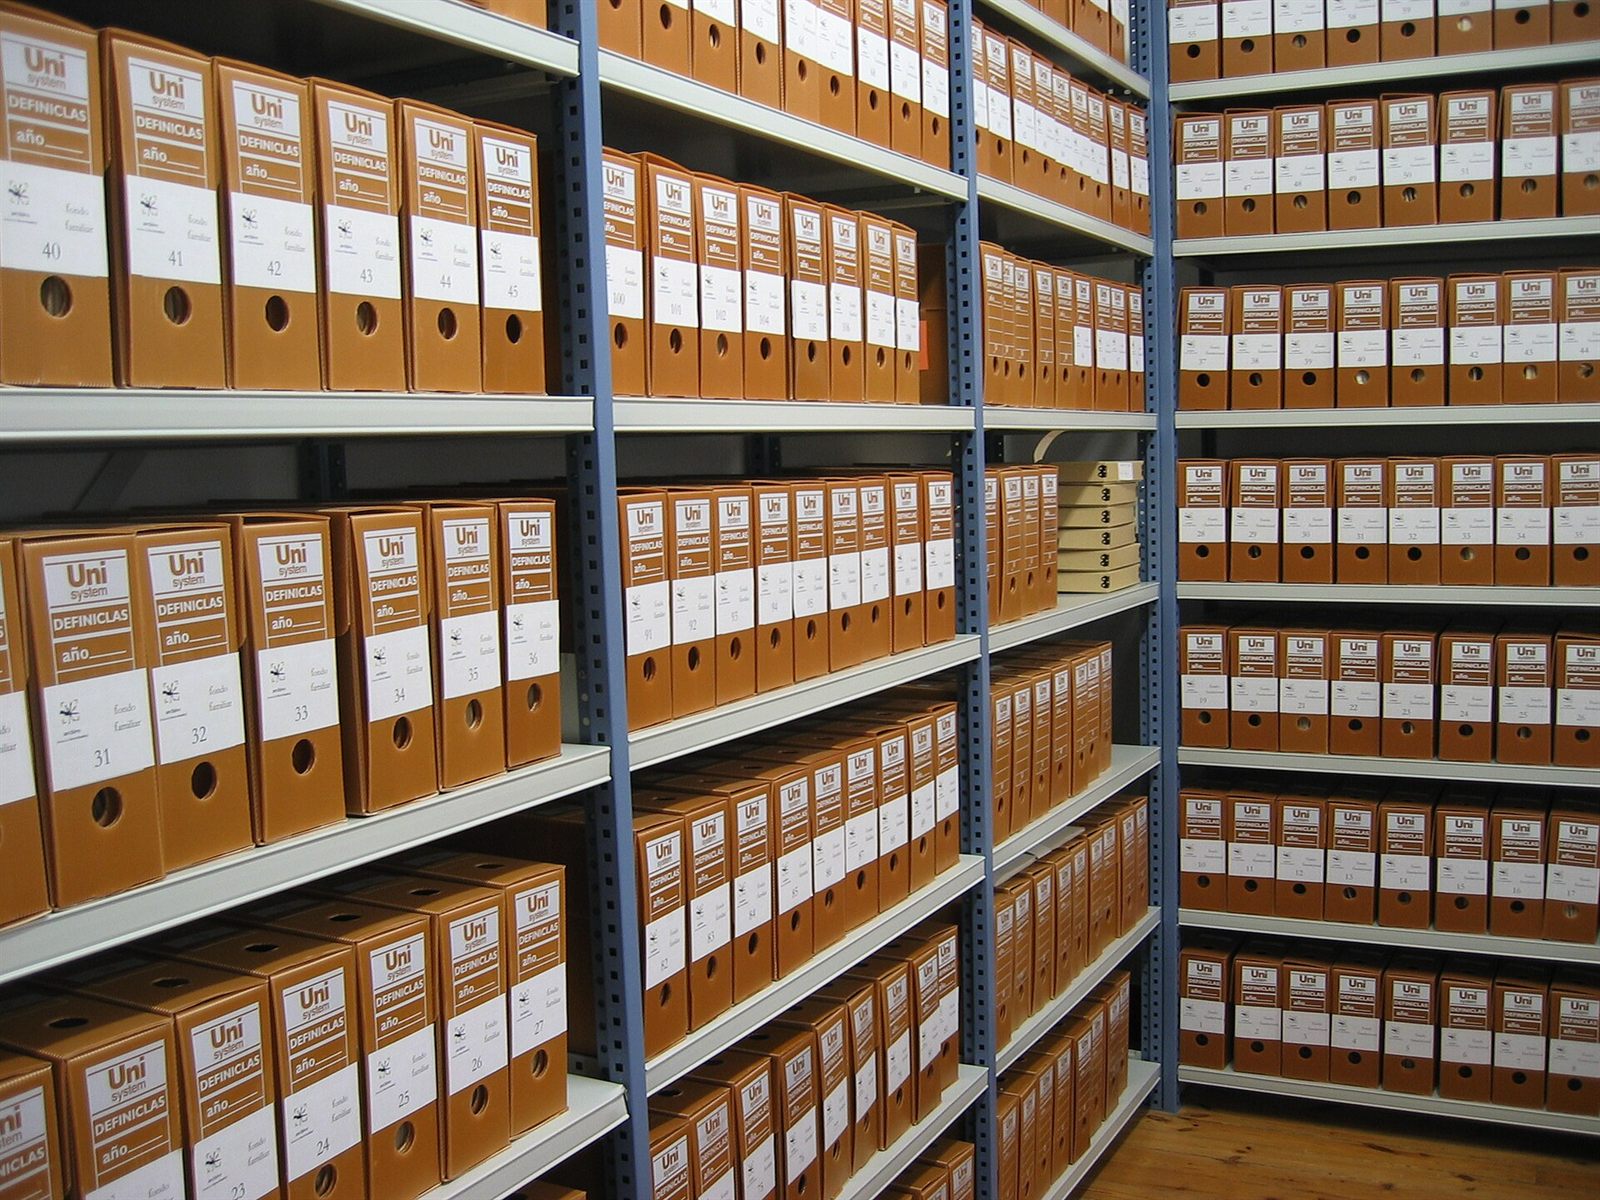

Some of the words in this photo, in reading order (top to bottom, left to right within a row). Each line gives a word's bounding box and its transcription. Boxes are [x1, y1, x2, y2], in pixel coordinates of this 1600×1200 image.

[24, 46, 67, 79] Uni
[27, 73, 66, 90] system
[150, 71, 185, 100] Uni
[8, 95, 88, 123] DEFINICLAS
[152, 95, 185, 111] system
[252, 93, 284, 120] Uni
[1521, 95, 1541, 105] Uni
[1399, 106, 1417, 115] Uni
[136, 115, 203, 140] DEFINICLAS
[253, 115, 284, 129] system
[344, 112, 373, 136] Uni
[1192, 123, 1209, 133] Uni
[1291, 115, 1309, 125] Uni
[16, 129, 45, 147] año
[239, 135, 300, 158] DEFINICLAS
[429, 129, 454, 152] Uni
[143, 146, 167, 163] año
[334, 151, 387, 172] DEFINICLAS
[496, 147, 519, 168] Uni
[246, 163, 268, 179] año
[419, 166, 467, 186] DEFINICLAS
[606, 168, 625, 184] Uni
[488, 181, 531, 200] DEFINICLAS
[666, 183, 683, 201] Uni
[712, 195, 729, 212] Uni
[756, 203, 772, 220] Uni
[42, 242, 61, 260] 40
[168, 250, 184, 267] 41
[267, 260, 282, 277] 42
[1410, 287, 1428, 297] Uni
[1521, 282, 1541, 292] Uni
[1253, 295, 1270, 304] Uni
[1195, 469, 1212, 478] Uni
[1299, 468, 1317, 477] Uni
[1462, 466, 1481, 476] Uni
[636, 509, 654, 525] Uni
[685, 505, 701, 521] Uni
[456, 526, 478, 545] Uni
[520, 519, 540, 537] Uni
[276, 543, 307, 566] Uni
[379, 536, 404, 556] Uni
[169, 552, 205, 576] Uni
[512, 554, 551, 567] DEFINICLAS
[66, 561, 108, 588] Uni
[279, 564, 307, 577] system
[448, 563, 489, 577] DEFINICLAS
[172, 574, 205, 589] system
[371, 575, 417, 592] DEFINICLAS
[70, 586, 108, 601] system
[265, 584, 322, 602] DEFINICLAS
[158, 596, 223, 616] DEFINICLAS
[54, 608, 129, 632] DEFINICLAS
[271, 614, 293, 630] año
[166, 630, 190, 646] año
[1248, 638, 1265, 648] Uni
[1350, 642, 1368, 651] Uni
[62, 646, 90, 663] año
[1517, 646, 1536, 656] Uni
[294, 705, 309, 722] 33
[191, 726, 208, 744] 32
[94, 748, 110, 768] 31
[745, 801, 760, 819] Uni
[1244, 806, 1261, 815] Uni
[701, 819, 716, 837] Uni
[1397, 816, 1415, 826] Uni
[1512, 823, 1530, 833] Uni
[655, 841, 672, 859] Uni
[527, 891, 549, 912] Uni
[463, 917, 487, 941] Uni
[519, 922, 559, 946] DEFINICLAS
[385, 945, 411, 971] Uni
[454, 950, 498, 976] DEFINICLAS
[300, 981, 329, 1009] Uni
[376, 979, 424, 1008] DEFINICLAS
[302, 1002, 330, 1021] system
[211, 1018, 243, 1049] Uni
[290, 1016, 344, 1050] DEFINICLAS
[214, 1040, 245, 1060] system
[108, 1056, 146, 1090] Uni
[200, 1053, 261, 1092] DEFINICLAS
[295, 1056, 316, 1075] año
[111, 1079, 147, 1102] system
[95, 1096, 166, 1137] DEFINICLAS
[206, 1099, 228, 1118] año
[0, 1106, 23, 1135] ni
[705, 1111, 720, 1134] Uni
[102, 1145, 128, 1165] año
[316, 1141, 330, 1157] 24
[662, 1147, 679, 1169] Uni
[231, 1182, 245, 1200] 23
